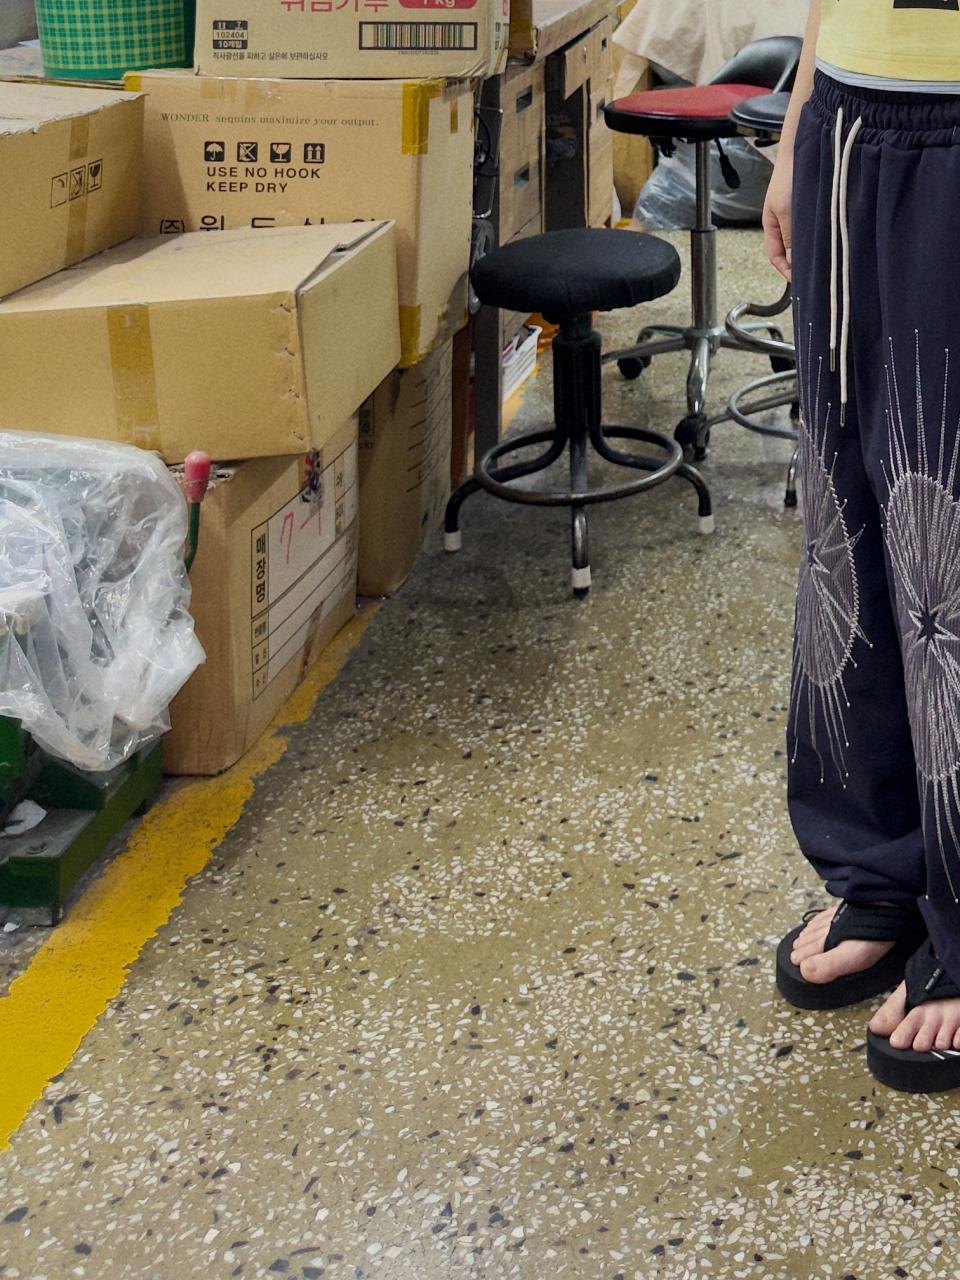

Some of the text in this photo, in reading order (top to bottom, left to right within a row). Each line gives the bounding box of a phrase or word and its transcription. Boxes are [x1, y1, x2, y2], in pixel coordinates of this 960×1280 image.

[206, 166, 321, 179] USE NO HOOK
[205, 181, 289, 193] KEEP DRY
